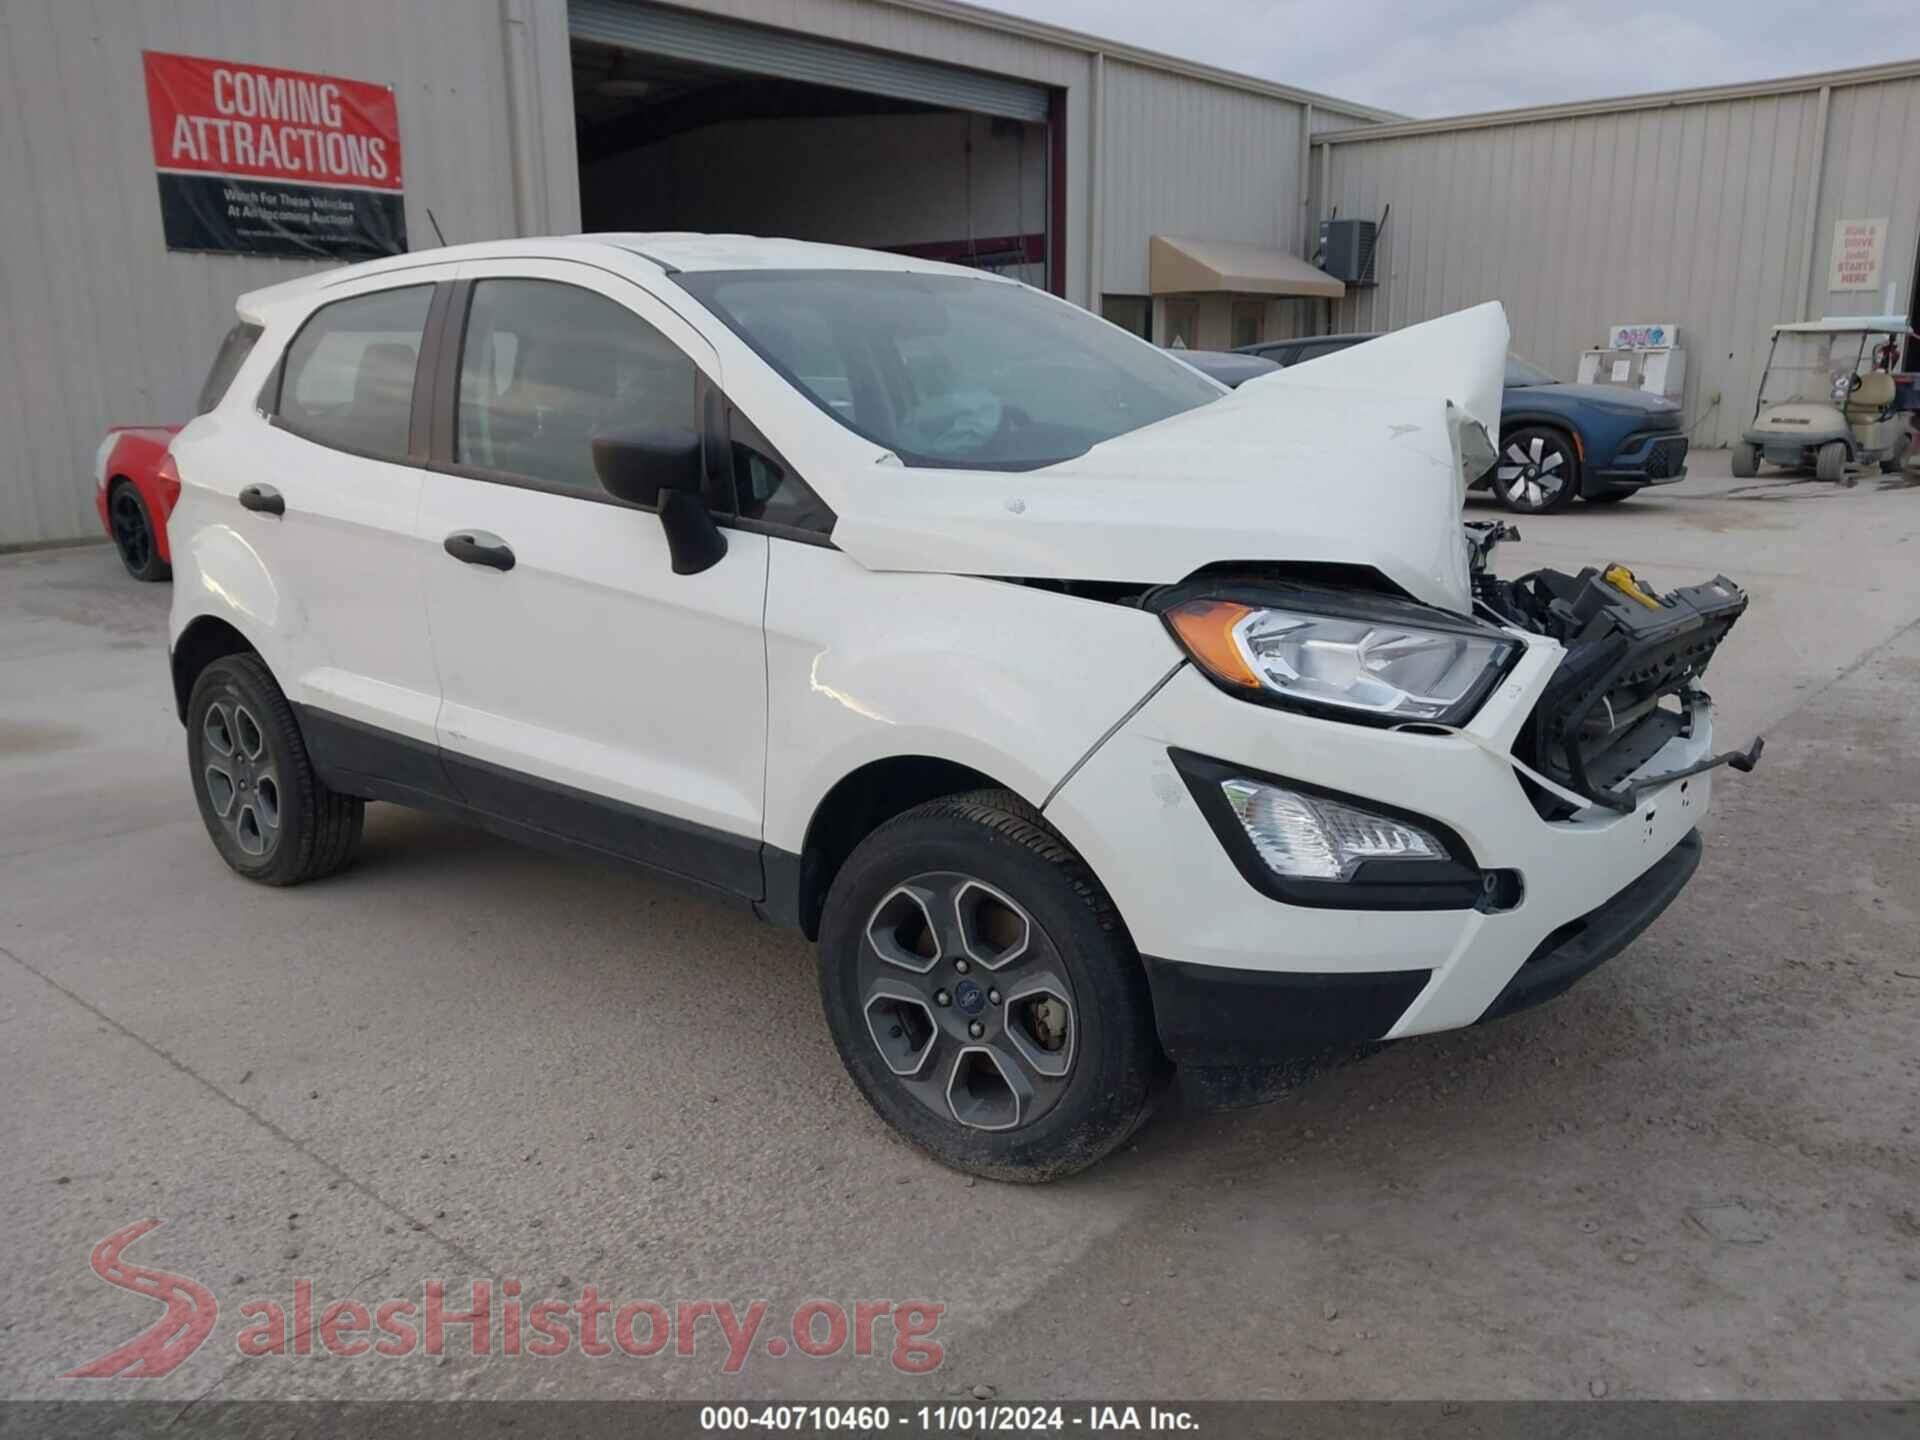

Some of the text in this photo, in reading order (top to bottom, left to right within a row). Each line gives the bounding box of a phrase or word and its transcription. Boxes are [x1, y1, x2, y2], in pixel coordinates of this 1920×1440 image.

[213, 69, 342, 128] COMING
[172, 114, 387, 179] ATTRACTIONS
[228, 205, 241, 217] At
[260, 191, 278, 204] For
[279, 193, 310, 208] These
